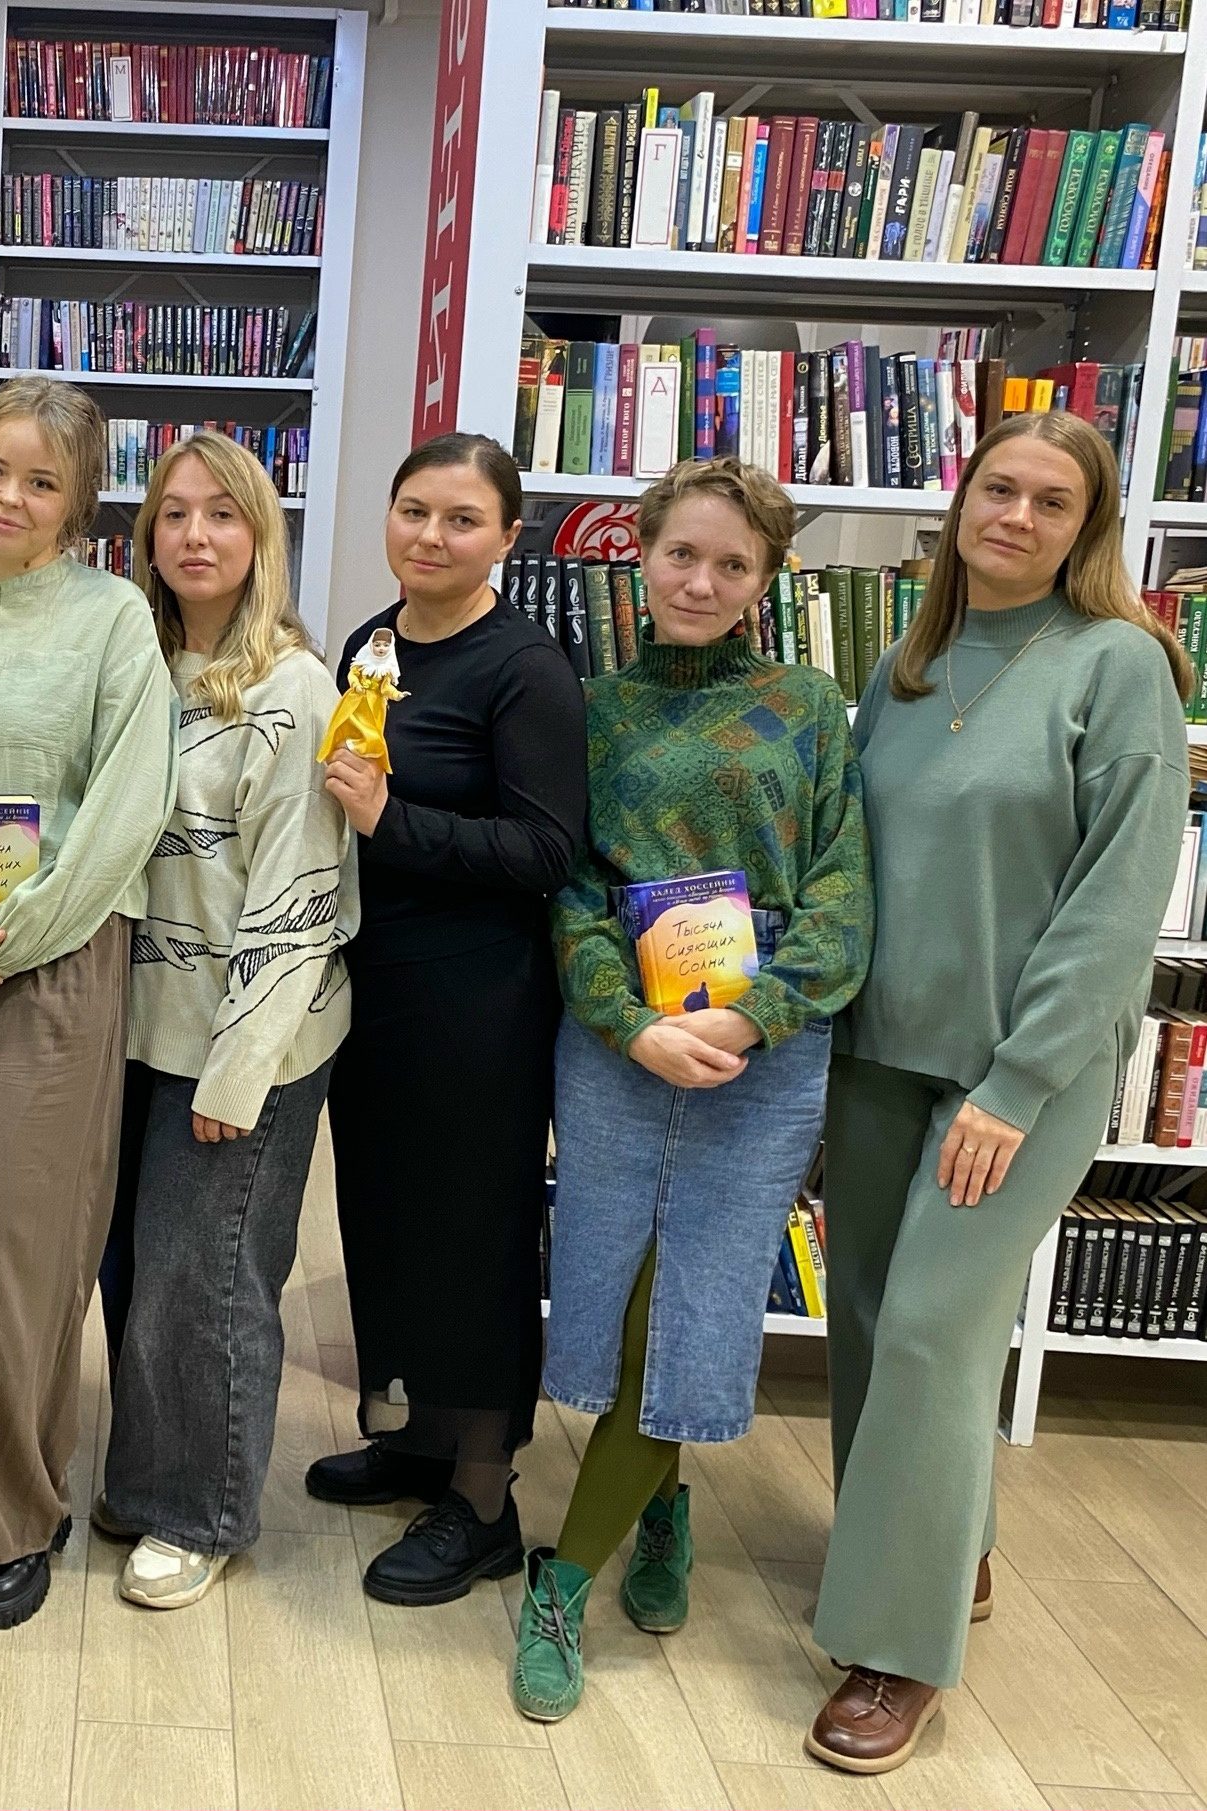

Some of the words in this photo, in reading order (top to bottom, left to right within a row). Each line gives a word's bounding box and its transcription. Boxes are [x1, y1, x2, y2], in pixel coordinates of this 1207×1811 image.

[114, 64, 126, 75] М
[654, 144, 666, 160] Г
[1004, 168, 1016, 193] ВОДЫ
[1143, 152, 1155, 191] ОБЕЩАНИЕ
[996, 194, 1010, 231] СЛОНАМ
[1058, 168, 1082, 233] ГОЛСУОРСИ
[1086, 168, 1110, 234] ГОЛСУОРСИ
[913, 217, 926, 246] ГОЛОС
[604, 350, 614, 382] ГРИЗЛИ
[651, 376, 667, 396] Д
[798, 385, 806, 414] Хроники
[622, 402, 630, 426] ГЮГО
[818, 405, 828, 442] Дюморье
[620, 428, 629, 460] ВИКТОР
[890, 435, 900, 473] НОВОСТИ
[795, 447, 807, 481] Дилан
[838, 582, 848, 630] ТРАГЕДИИ
[864, 583, 873, 631] ТРАГЕДИИ
[1190, 611, 1202, 652] КОНСУЭЛО
[650, 886, 681, 897] ХАЛЕД
[683, 879, 736, 892] ХОССЕЙНИ
[672, 919, 724, 938] Тысяча
[665, 936, 737, 961] Сияющих
[678, 958, 725, 977] Солнц
[1185, 1077, 1198, 1127] ОЖИДАНИЕ
[1057, 1305, 1065, 1315] 4
[1076, 1309, 1085, 1318] 5
[1093, 1308, 1102, 1317] 6
[1113, 1309, 1122, 1318] 7
[1132, 1313, 1140, 1322] 2
[1152, 1315, 1157, 1324] 1
[1167, 1312, 1175, 1321] 8
[1187, 1311, 1195, 1321] 8
